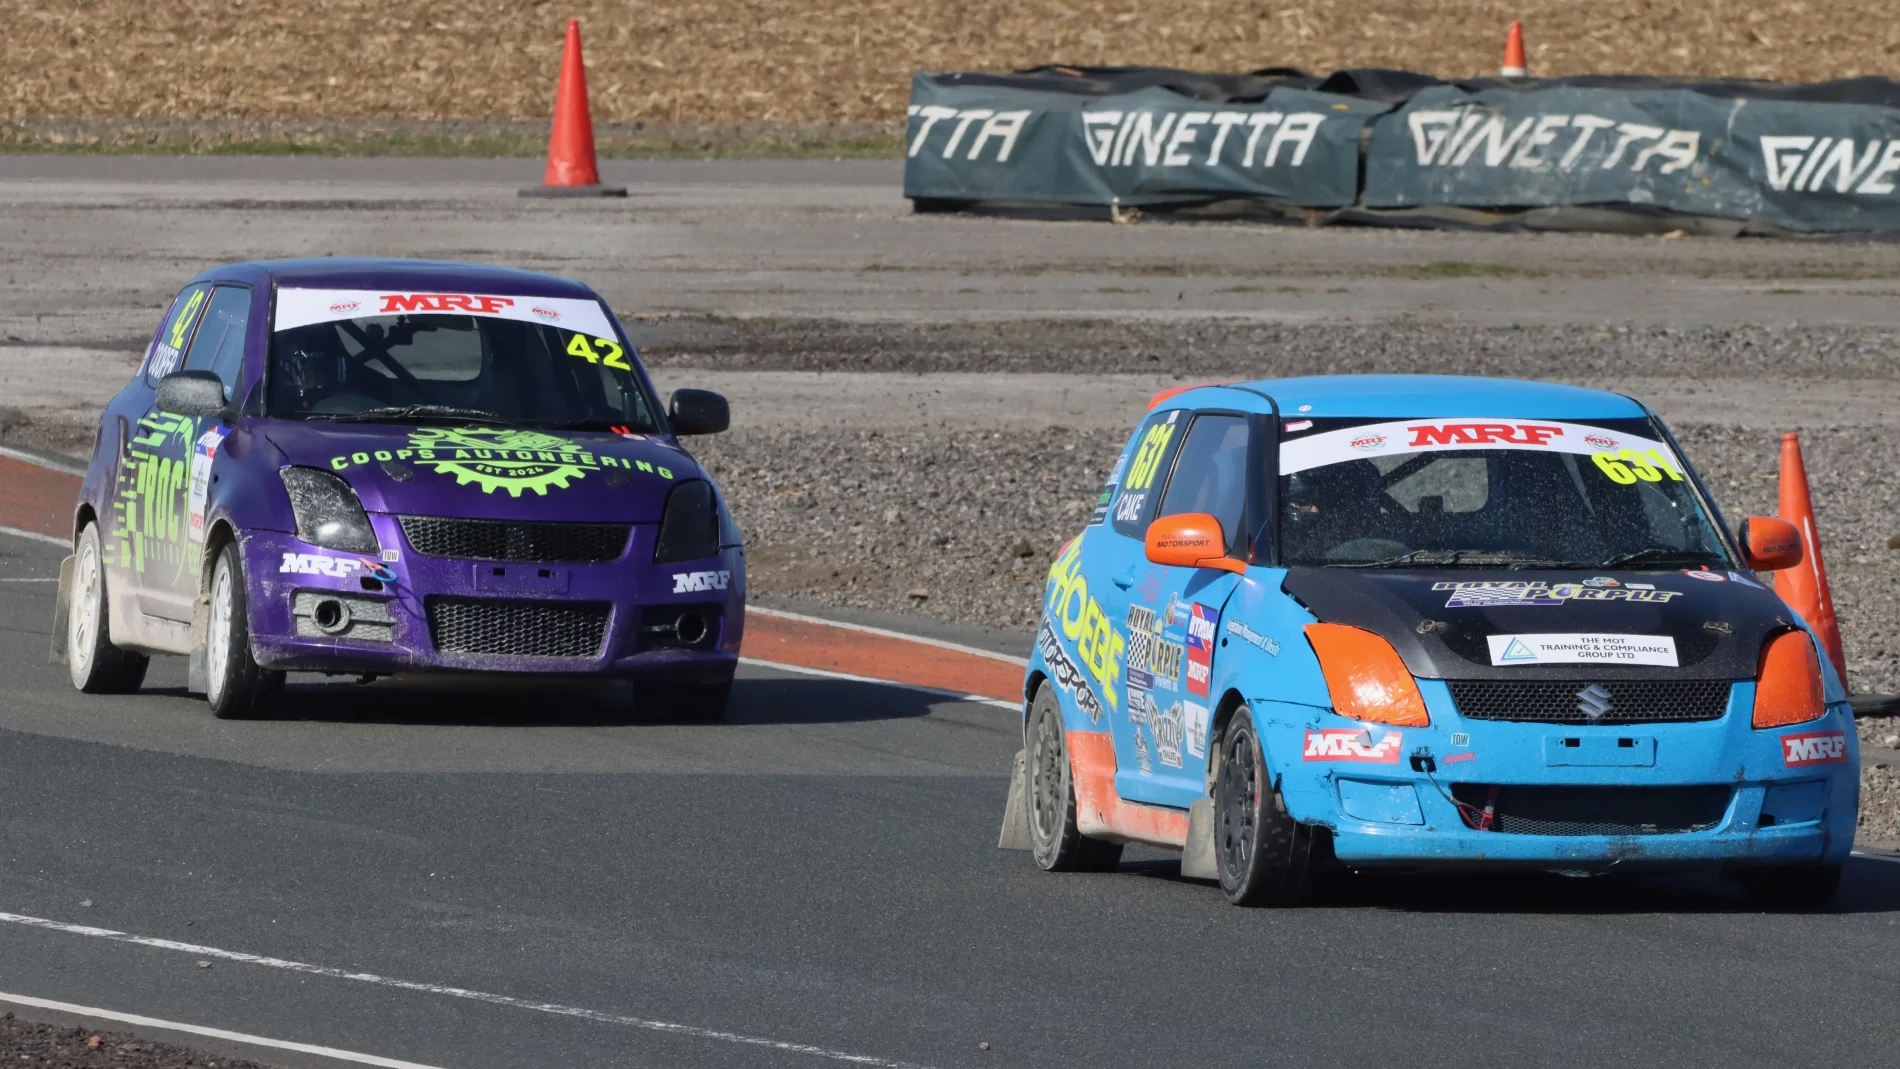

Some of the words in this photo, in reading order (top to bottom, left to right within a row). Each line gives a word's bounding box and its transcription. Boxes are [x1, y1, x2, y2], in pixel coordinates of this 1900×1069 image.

[907, 105, 1032, 162] TTA
[1081, 110, 1327, 168] GINETTA
[1408, 110, 1701, 175] GINETTA
[379, 294, 515, 314] MRF
[170, 289, 204, 350] 42
[566, 333, 632, 372] 42
[1349, 436, 1388, 447] MRF
[1406, 423, 1565, 447] MRF
[1583, 436, 1620, 447] MRF
[331, 449, 435, 471] COOPS
[456, 449, 674, 480] AUTONEERING
[475, 463, 502, 475] EST
[1126, 423, 1176, 490] 631
[1591, 447, 1685, 485] 631
[1116, 493, 1145, 521] CAKE
[383, 551, 398, 561] TOW
[1156, 539, 1211, 549] MOTORSPORT
[279, 552, 361, 578] MRF
[673, 570, 730, 594] MRF
[1430, 581, 1548, 591] ROYAL
[1521, 584, 1675, 603] PURPLE
[1127, 604, 1156, 633] ROYAL
[1143, 636, 1184, 681] PURPLE
[1578, 651, 1614, 659] GROUP
[1603, 644, 1670, 654] COMPLIANCE
[1187, 659, 1209, 684] MRF
[1154, 716, 1182, 753] GRIZZLY
[1304, 733, 1400, 758] MRF
[1452, 734, 1469, 745] TOW
[1785, 735, 1845, 762] MRF
